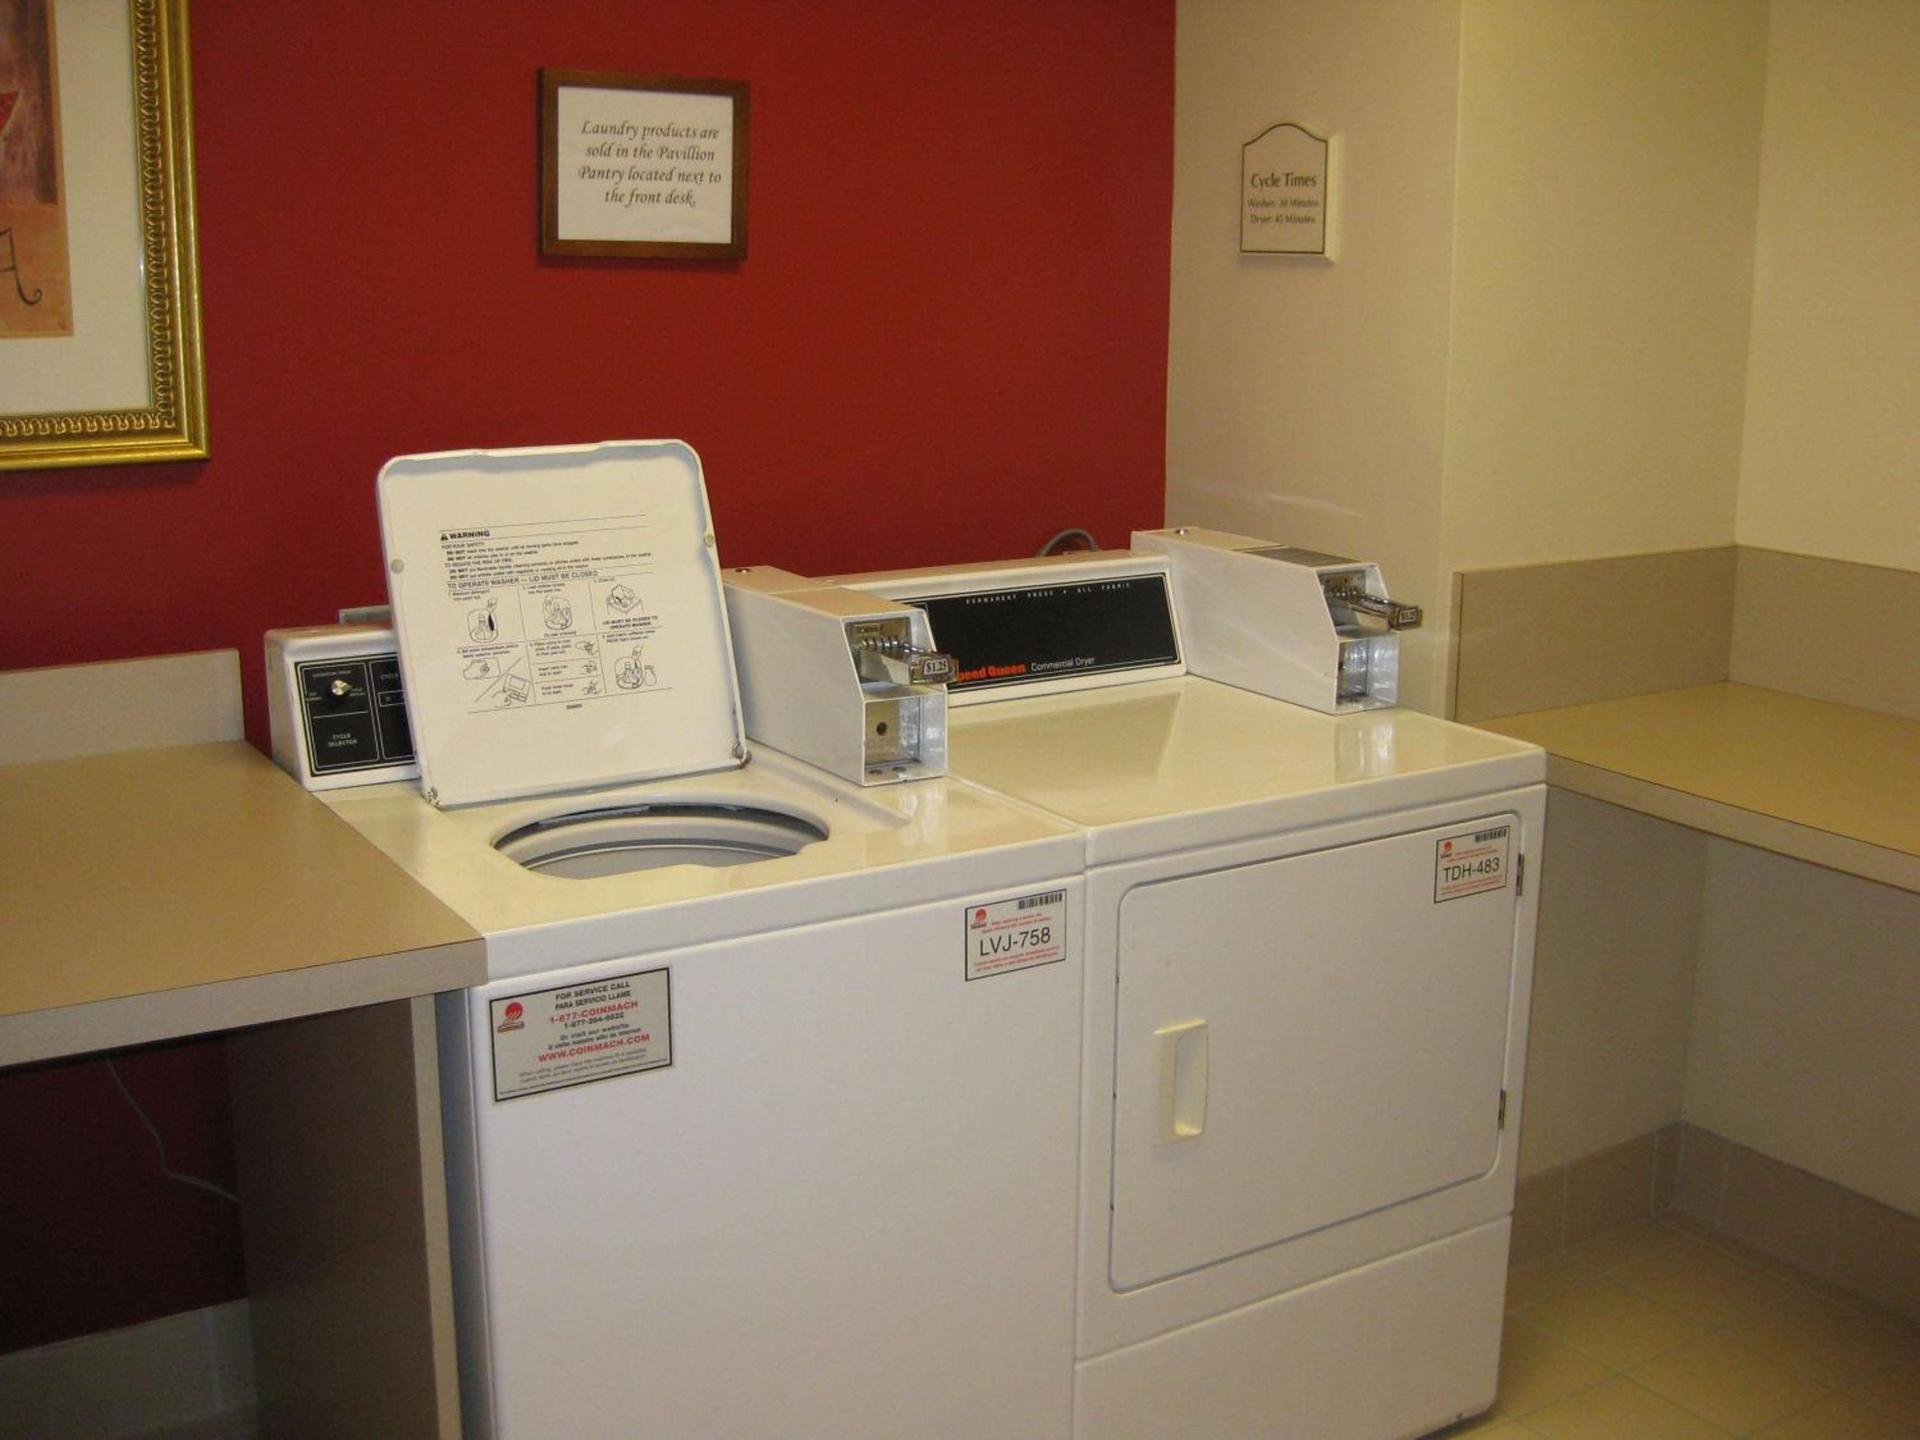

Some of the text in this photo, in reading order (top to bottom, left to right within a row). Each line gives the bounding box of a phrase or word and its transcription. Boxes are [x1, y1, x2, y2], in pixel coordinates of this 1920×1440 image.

[581, 120, 719, 141] Laundry products are
[585, 144, 715, 161] sold in the Pavillion
[578, 166, 722, 186] Pantry located next to
[1251, 172, 1317, 190] Cycle Times
[605, 188, 625, 204] the
[625, 188, 661, 208] front
[449, 530, 490, 540] WARNING
[491, 577, 519, 586] WASHER
[541, 573, 559, 581] MUST
[571, 570, 598, 579] CLOSED
[957, 656, 1096, 681] peed Queen Commercial Dryer
[1443, 857, 1500, 882] TDH-483
[980, 926, 1051, 956] LVJ-758
[555, 981, 631, 1001] FOR SERVICE CALL
[550, 1000, 638, 1024] 1-877-COINMACH
[555, 1002, 573, 1011] PARA
[537, 1033, 651, 1062] WWW.COINMACH.COM
